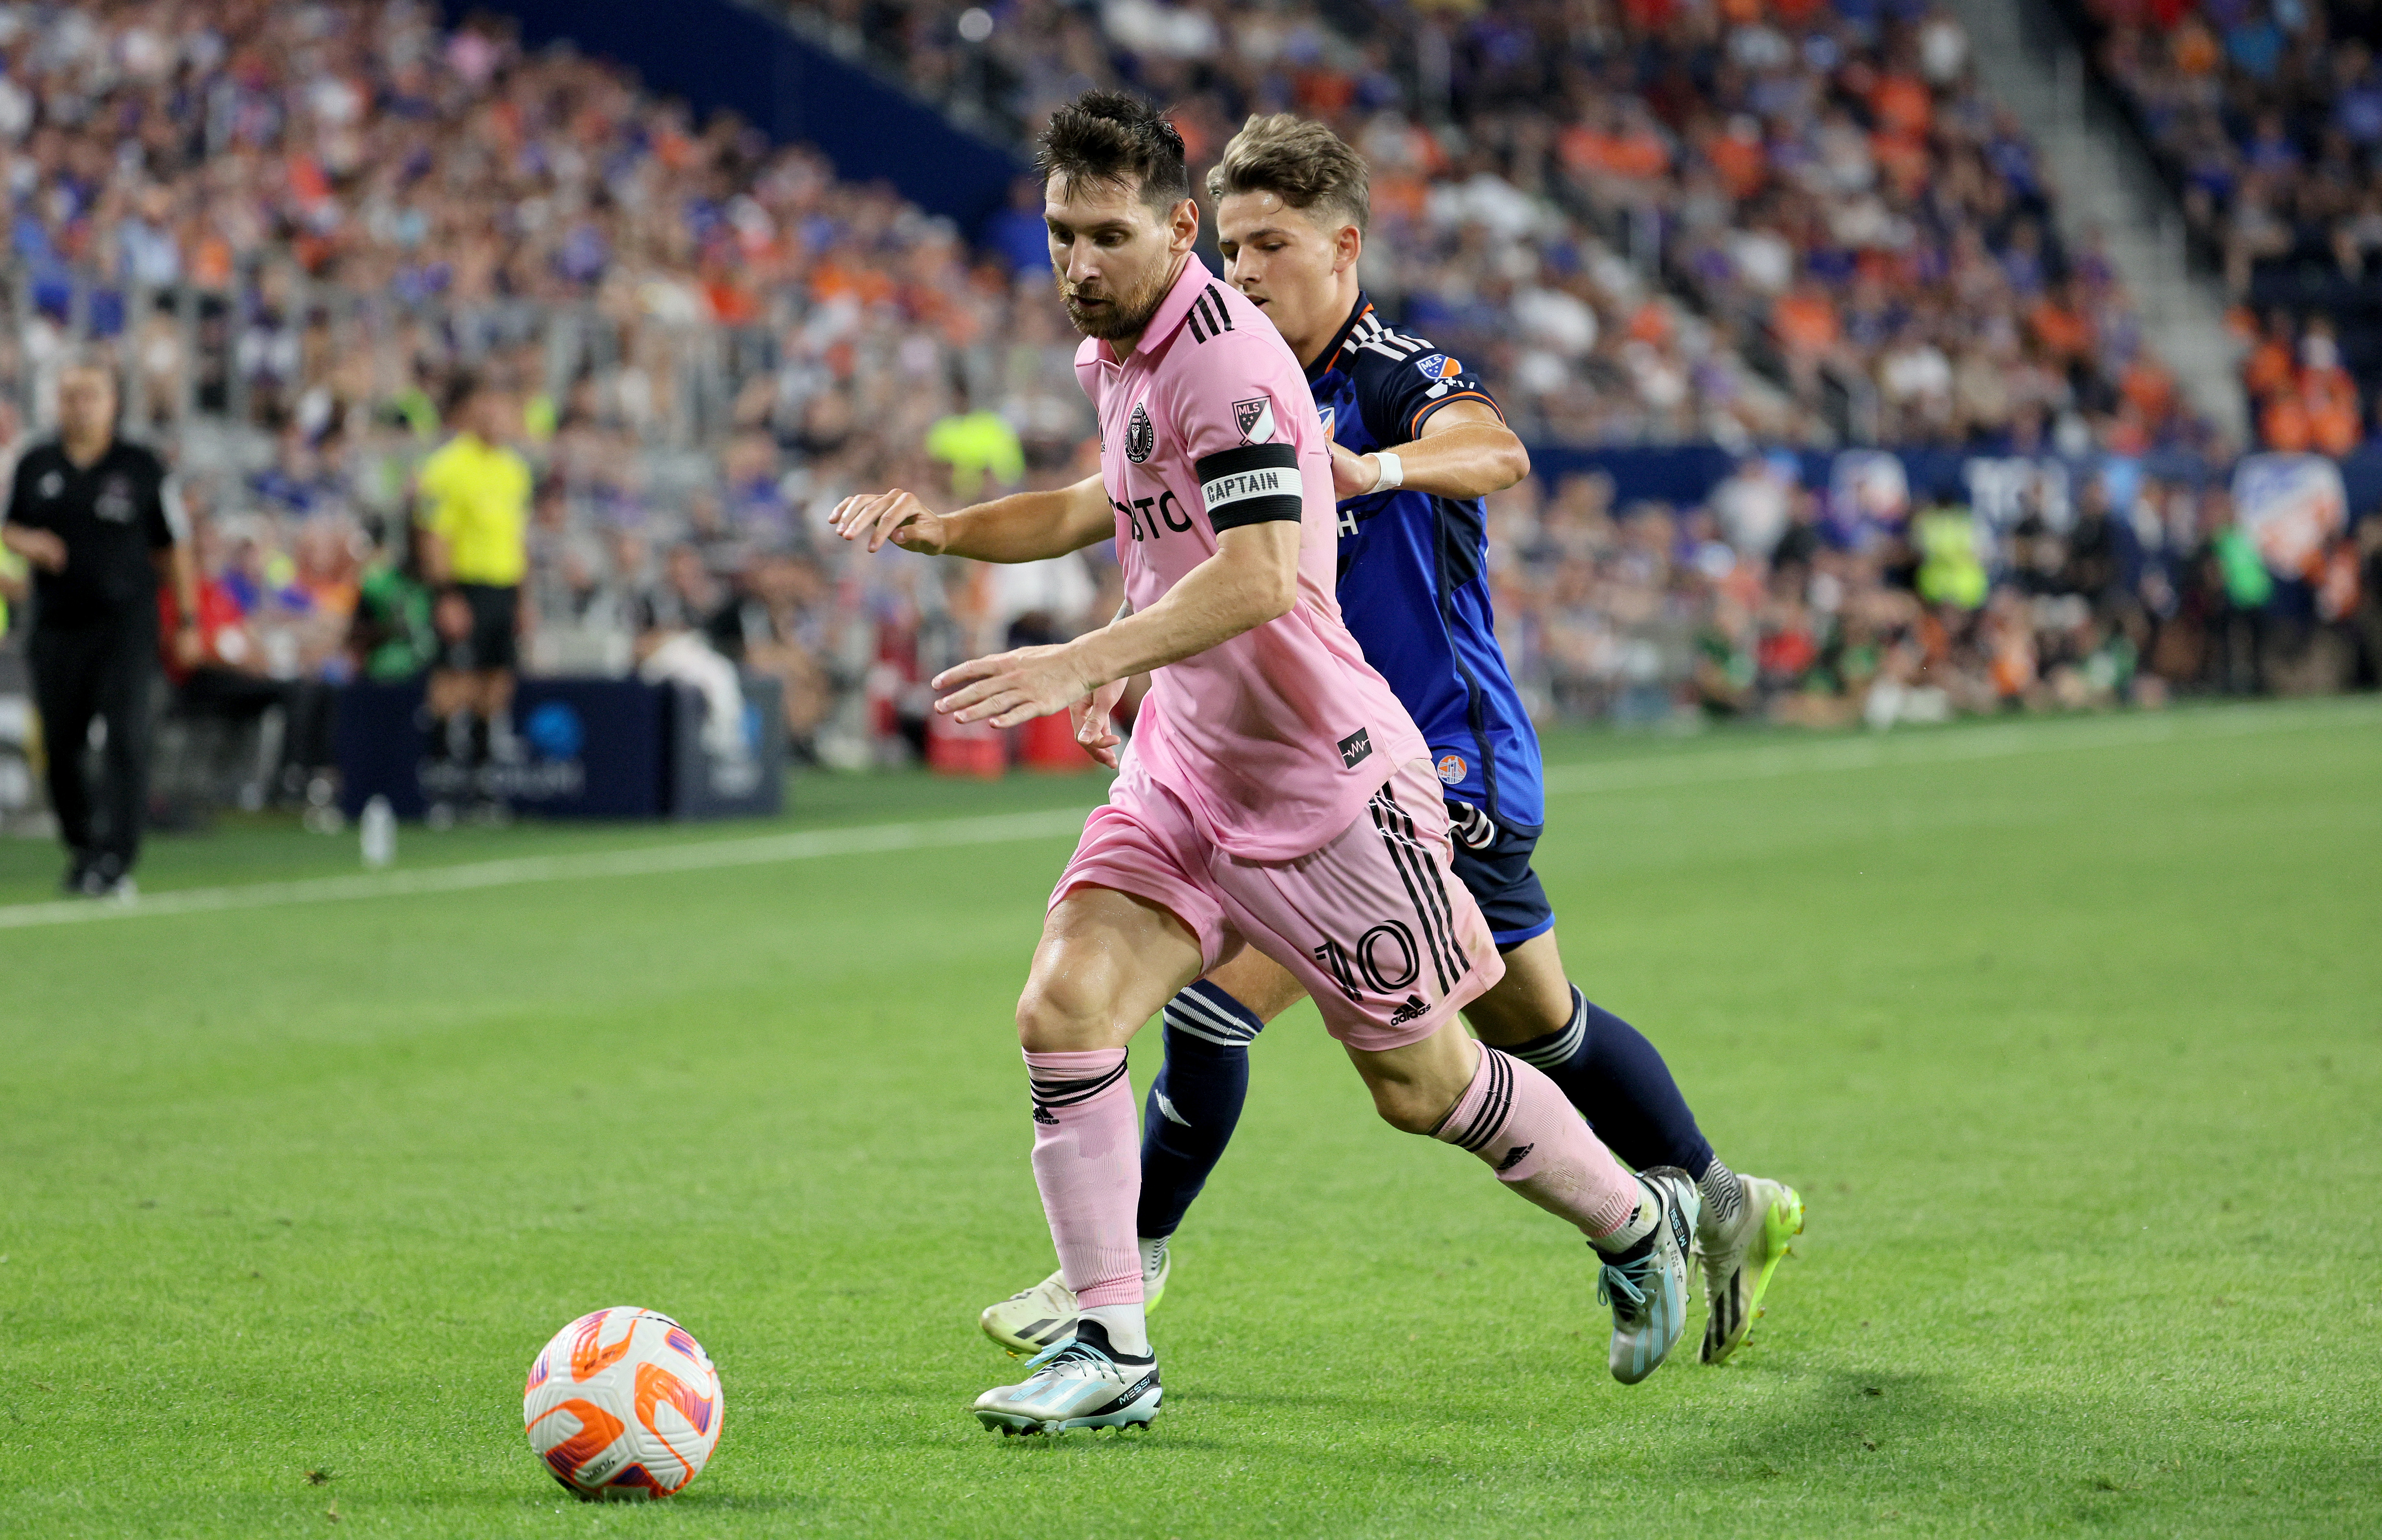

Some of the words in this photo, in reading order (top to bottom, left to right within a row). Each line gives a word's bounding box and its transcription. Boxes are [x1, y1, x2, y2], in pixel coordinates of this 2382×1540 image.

[1419, 356, 1442, 370] MLS
[1238, 403, 1260, 416] MLS
[1207, 472, 1279, 503] CAPTAIN
[1314, 920, 1420, 1001] 10
[1390, 1003, 1431, 1026] adidas
